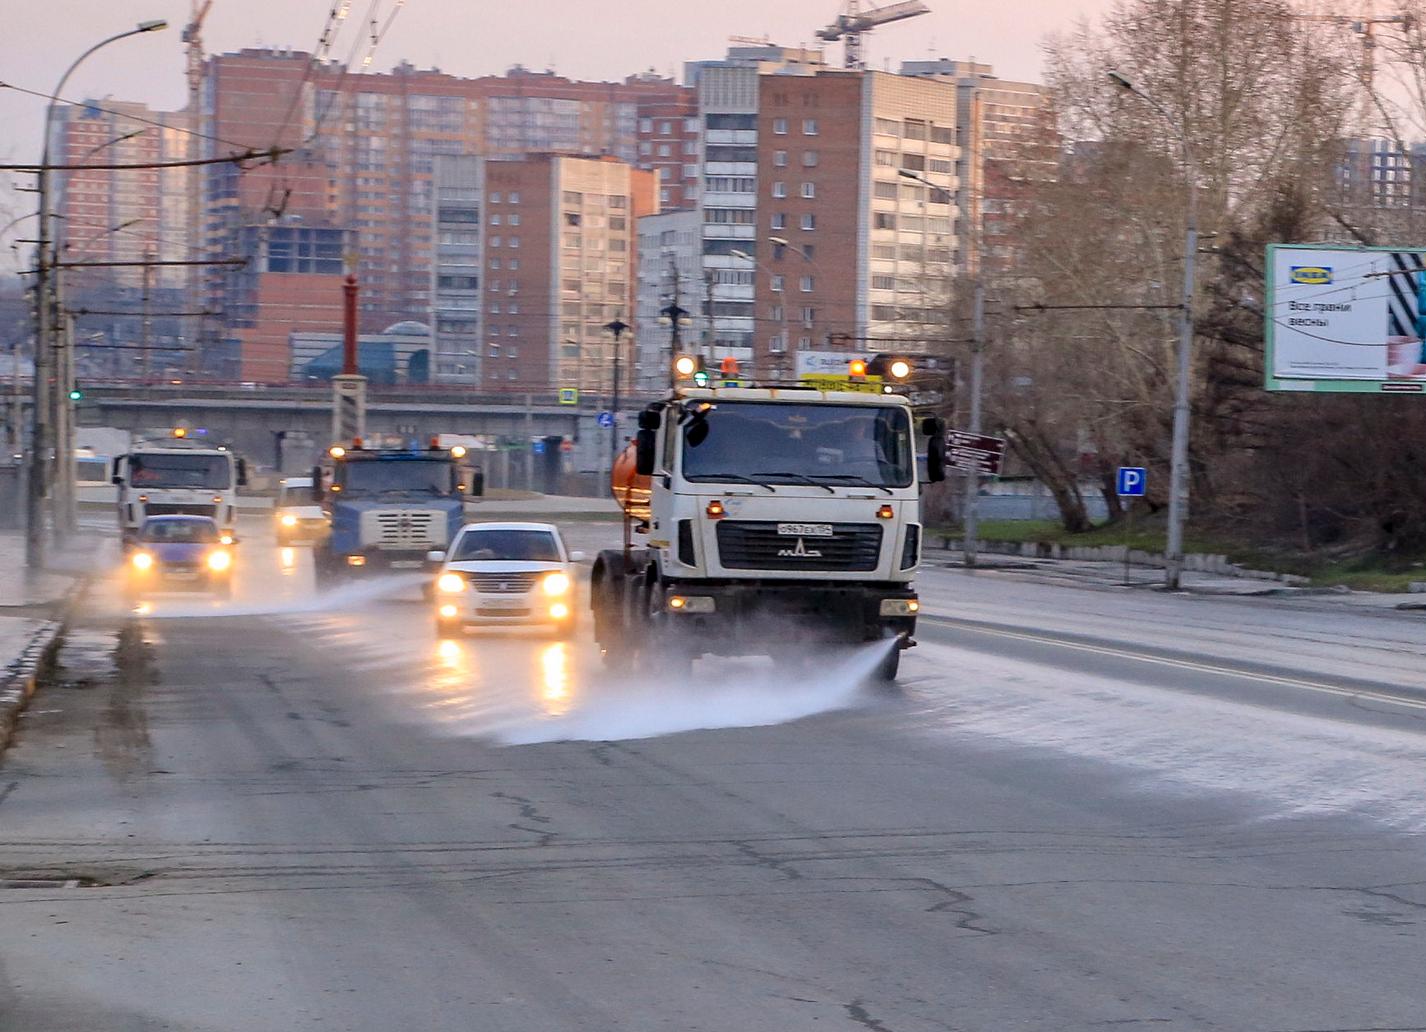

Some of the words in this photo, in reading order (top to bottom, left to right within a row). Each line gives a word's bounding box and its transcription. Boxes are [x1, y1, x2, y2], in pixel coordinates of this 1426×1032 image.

[1289, 300, 1311, 311] Все
[1313, 303, 1352, 314] грани
[1289, 317, 1328, 326] весны
[1124, 470, 1140, 491] P
